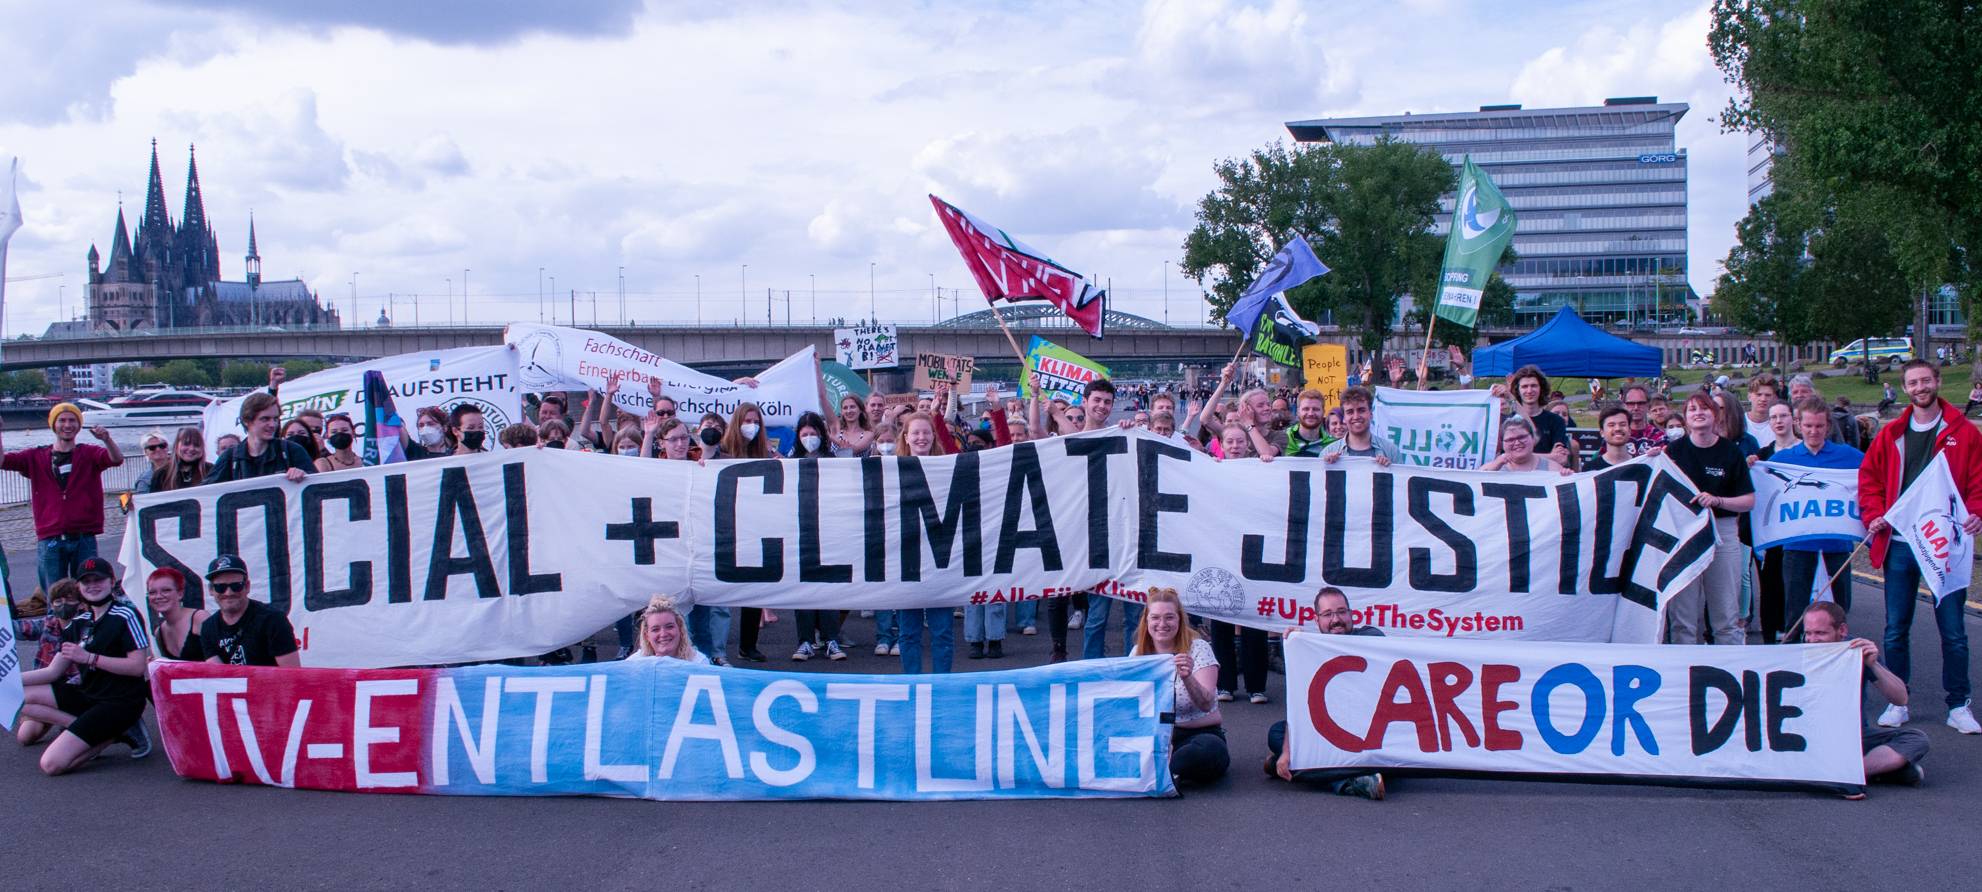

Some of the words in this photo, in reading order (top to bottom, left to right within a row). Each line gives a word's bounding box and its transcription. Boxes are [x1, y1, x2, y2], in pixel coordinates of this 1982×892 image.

[856, 338, 870, 346] NO
[857, 342, 896, 352] PLANET
[862, 351, 873, 361] B!
[1308, 356, 1341, 372] People
[928, 368, 962, 381] WENE
[1317, 376, 1336, 384] NOT
[1323, 388, 1342, 405] ofit
[138, 462, 562, 630] SOCIAL
[605, 497, 679, 565] +
[714, 436, 1192, 583] CLIMATE
[1241, 463, 1715, 611] JUSTICE
[1257, 596, 1524, 637] #UpotTheSystem
[1308, 655, 1523, 753] CARE
[1530, 662, 1662, 757] OR
[1690, 665, 1807, 757] DIE
[170, 674, 1155, 793] TV-ENTLASTUNG
